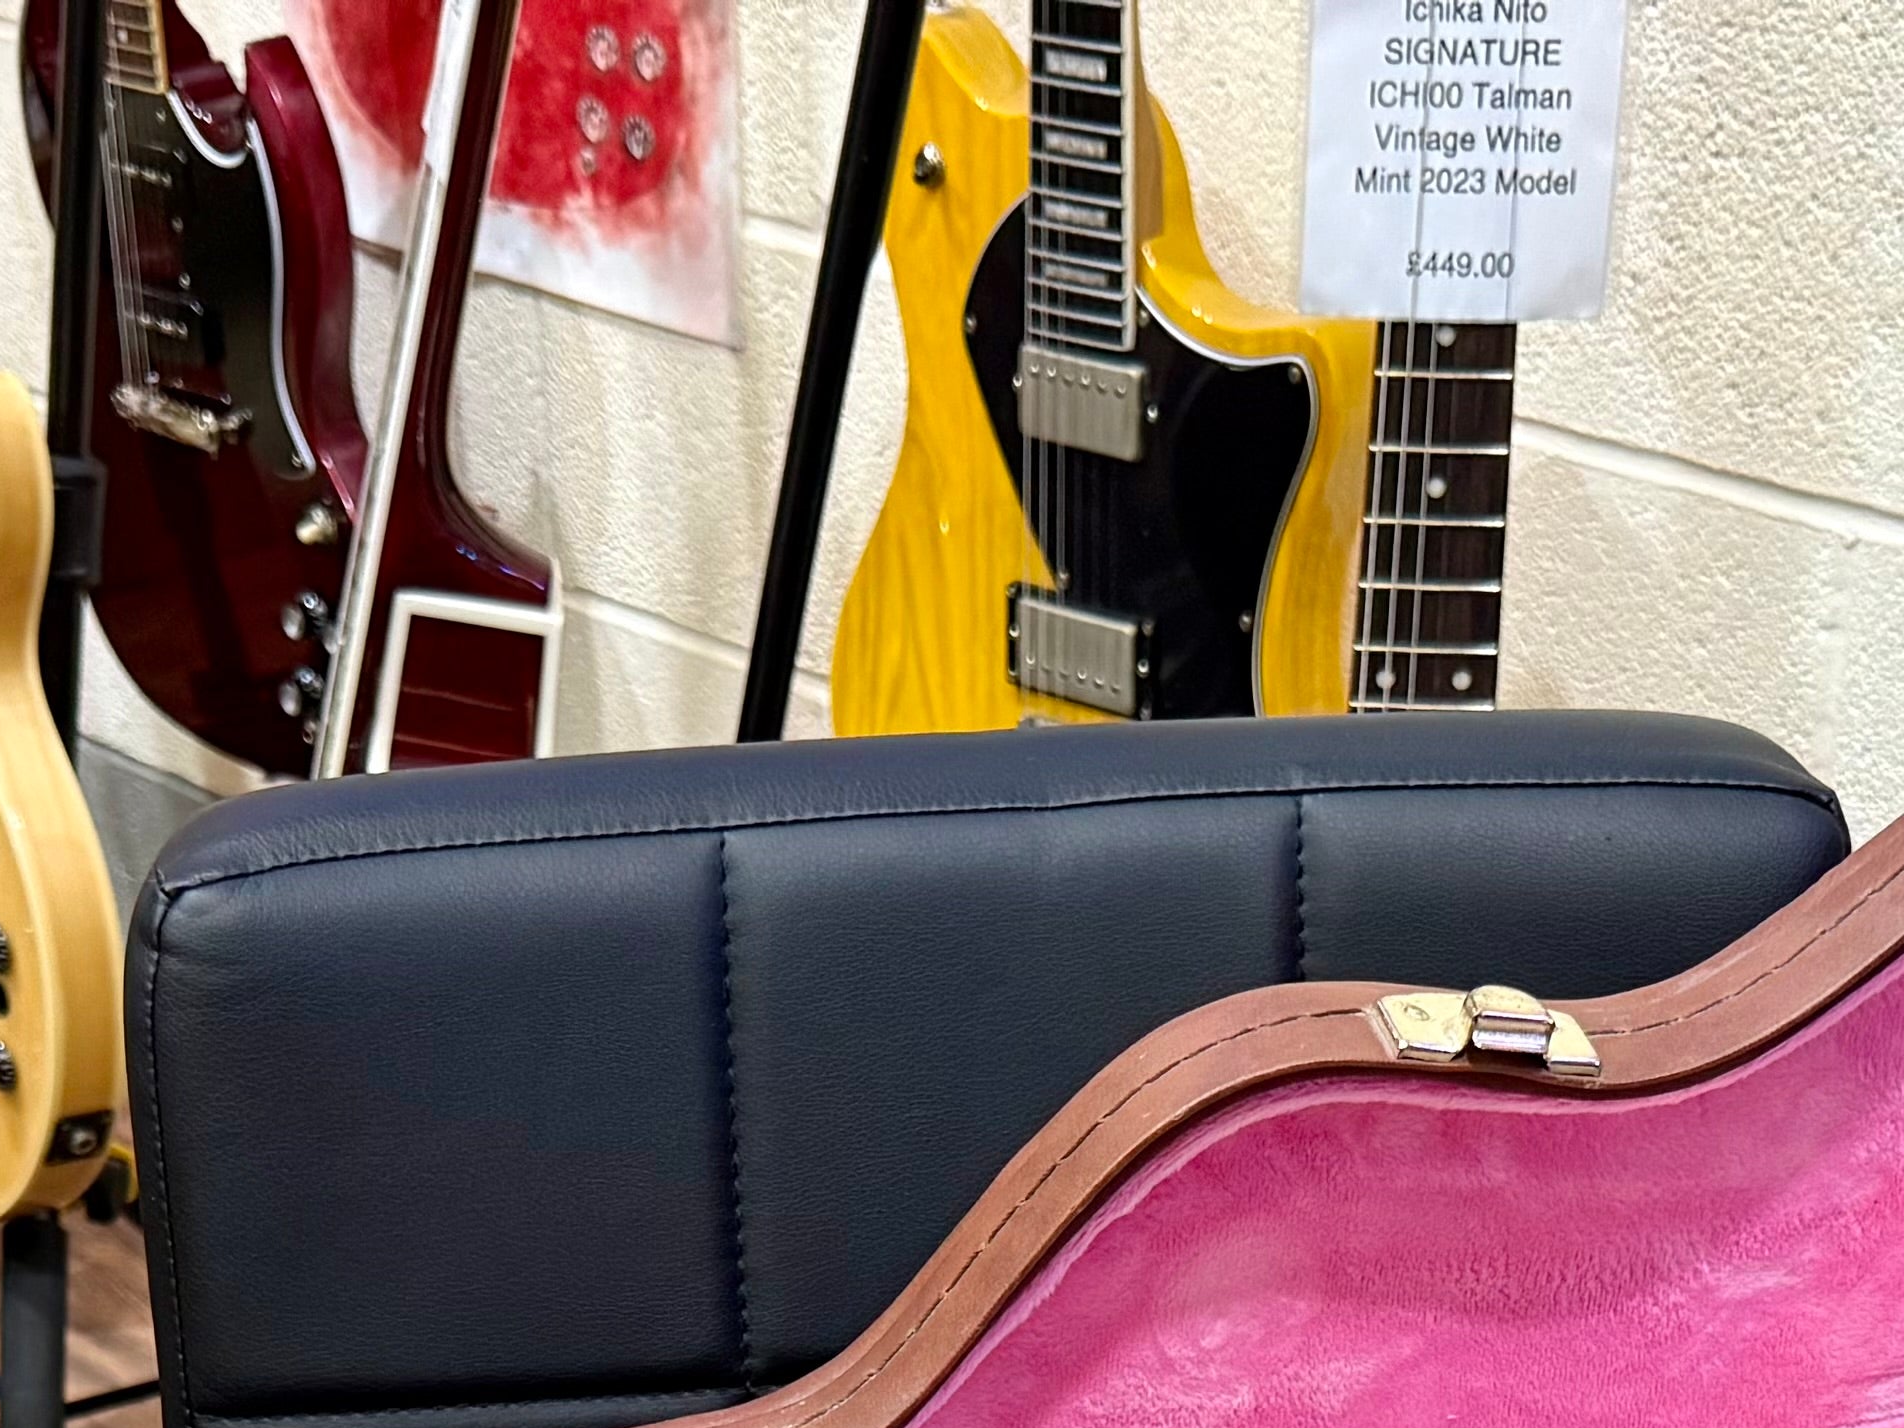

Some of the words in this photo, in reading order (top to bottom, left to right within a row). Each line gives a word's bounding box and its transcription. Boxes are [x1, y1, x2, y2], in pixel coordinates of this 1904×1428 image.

[1405, 0, 1482, 24] Ichika
[1494, 0, 1548, 24] Nito
[1384, 38, 1562, 67] SIGNATURE
[1473, 80, 1572, 110] Talman
[1375, 125, 1476, 157] Vintage
[1485, 125, 1561, 153] White
[1355, 167, 1411, 194] Mint
[1420, 167, 1486, 195] 2023
[1495, 167, 1578, 196] Model
[1406, 252, 1515, 279] £449.00
